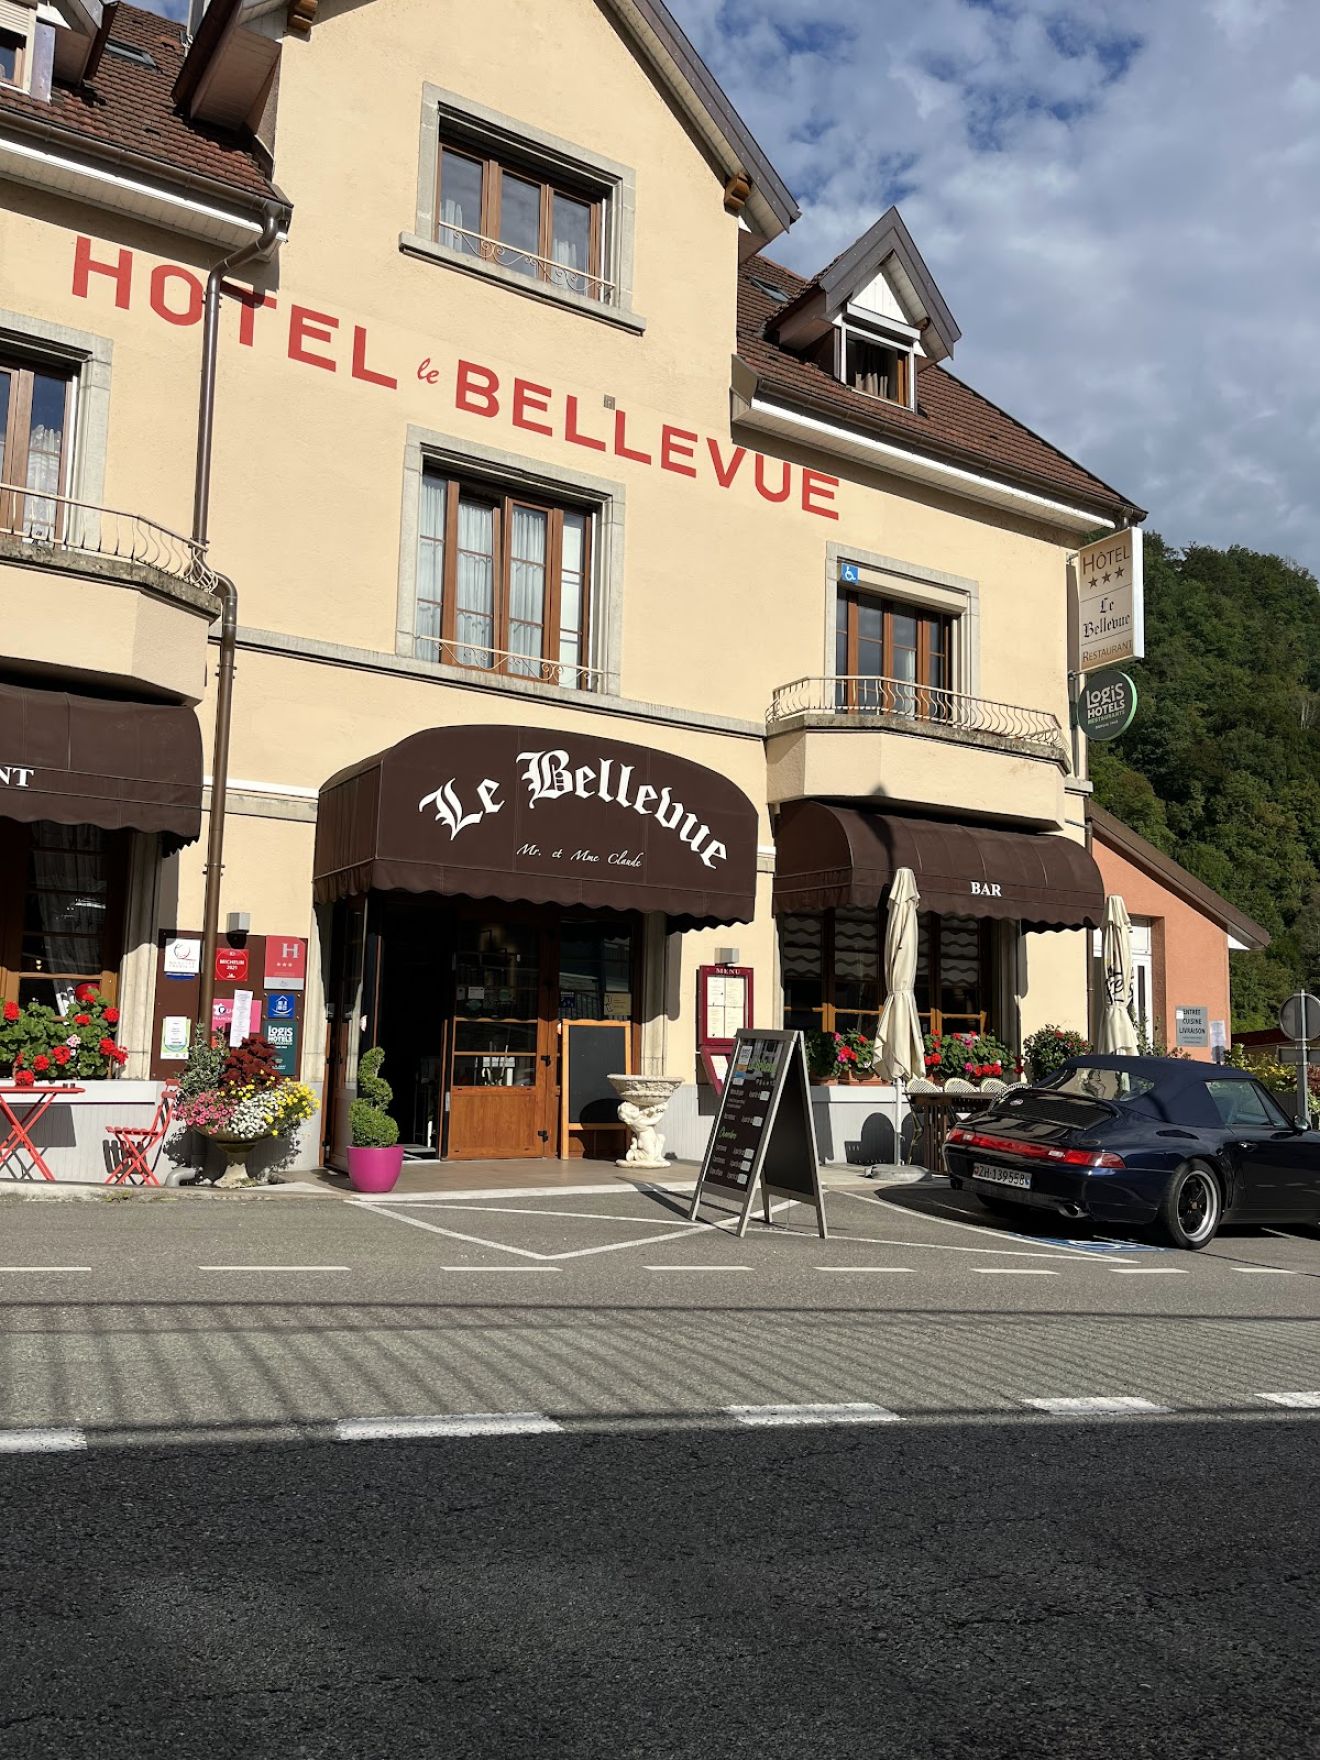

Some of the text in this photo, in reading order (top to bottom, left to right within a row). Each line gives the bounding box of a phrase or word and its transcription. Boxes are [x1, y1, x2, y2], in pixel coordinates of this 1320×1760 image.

[72, 235, 840, 521] HOTEL le BELLEVUE
[1083, 545, 1130, 575] HÔTEL
[1100, 597, 1115, 613] Le
[1083, 614, 1131, 638] Bellevue
[1083, 640, 1132, 662] RESTAURANT
[1087, 699, 1125, 719] HOTELS
[417, 749, 728, 870] Le Bellevue
[516, 843, 644, 868] Mr. et Mme Claude
[970, 881, 1002, 897] BAR
[281, 943, 299, 959] H
[715, 967, 741, 975] MENU
